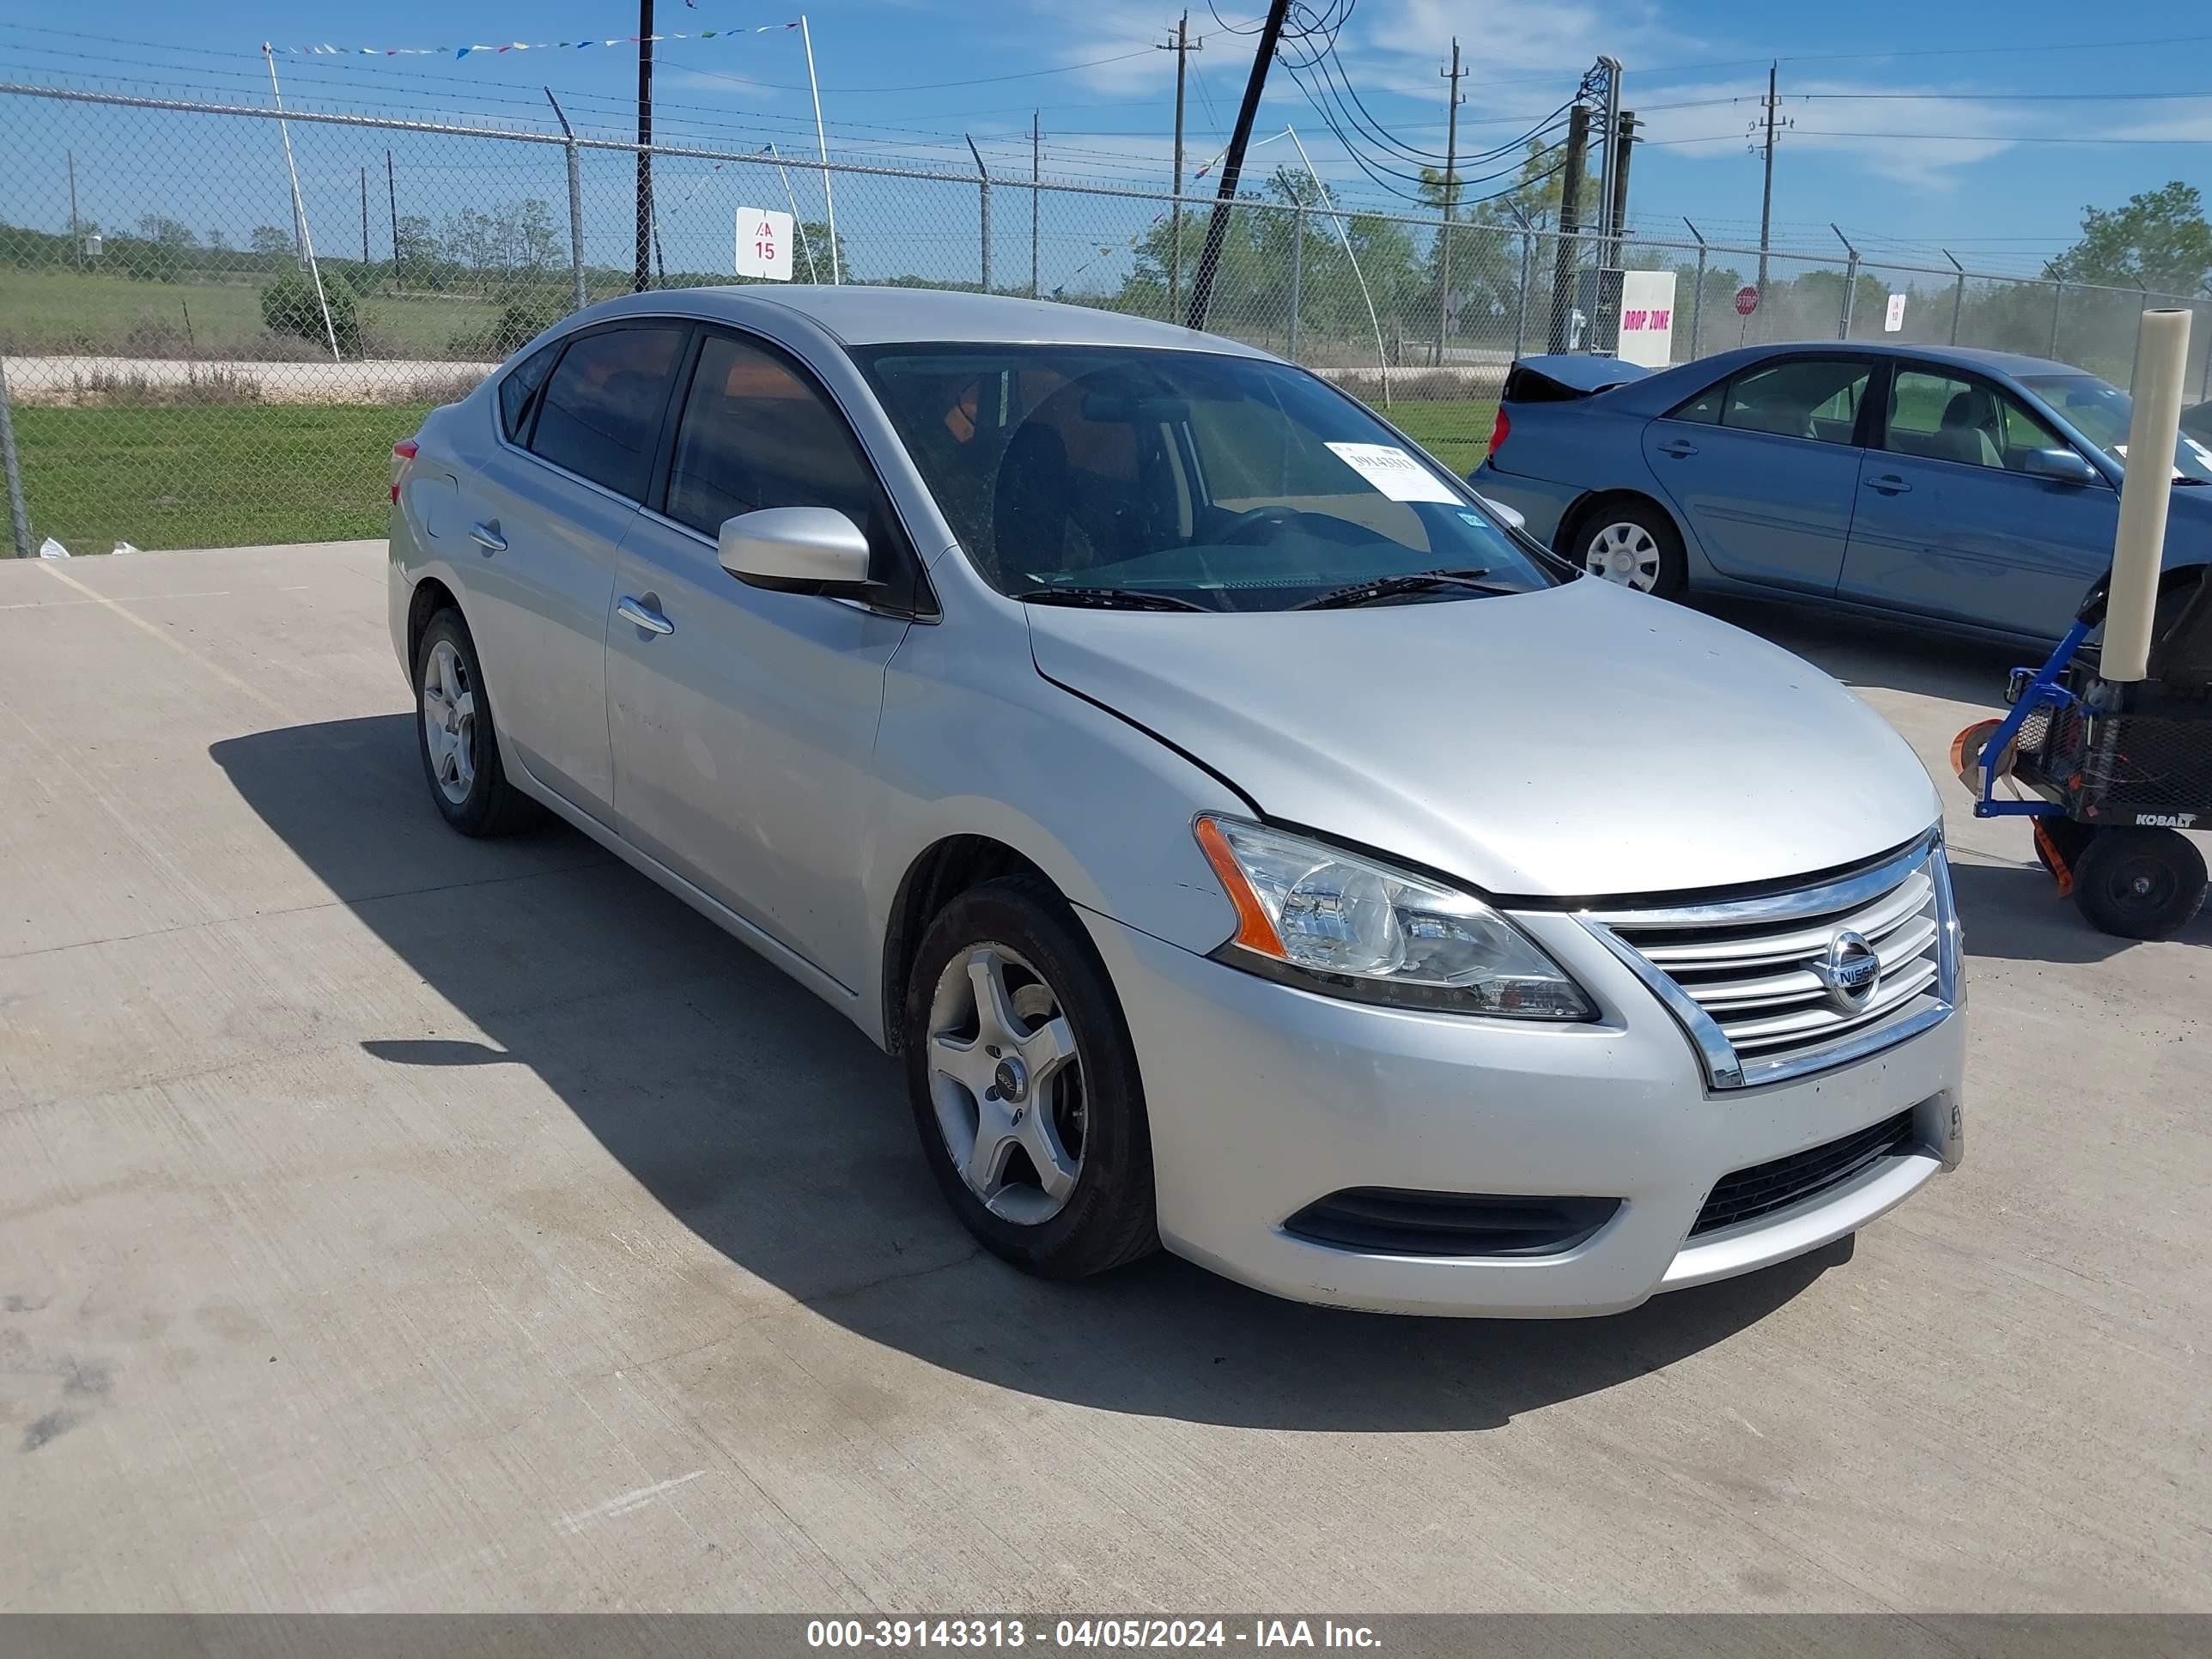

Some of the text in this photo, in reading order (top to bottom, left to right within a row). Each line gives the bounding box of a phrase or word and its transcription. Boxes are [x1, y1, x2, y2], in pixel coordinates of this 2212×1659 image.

[756, 242, 775, 259] 15
[1736, 294, 1759, 307] STOP
[1624, 310, 1670, 331] DROP ZONE
[1350, 455, 1416, 471] 39143313
[2136, 812, 2197, 828] KOBALT
